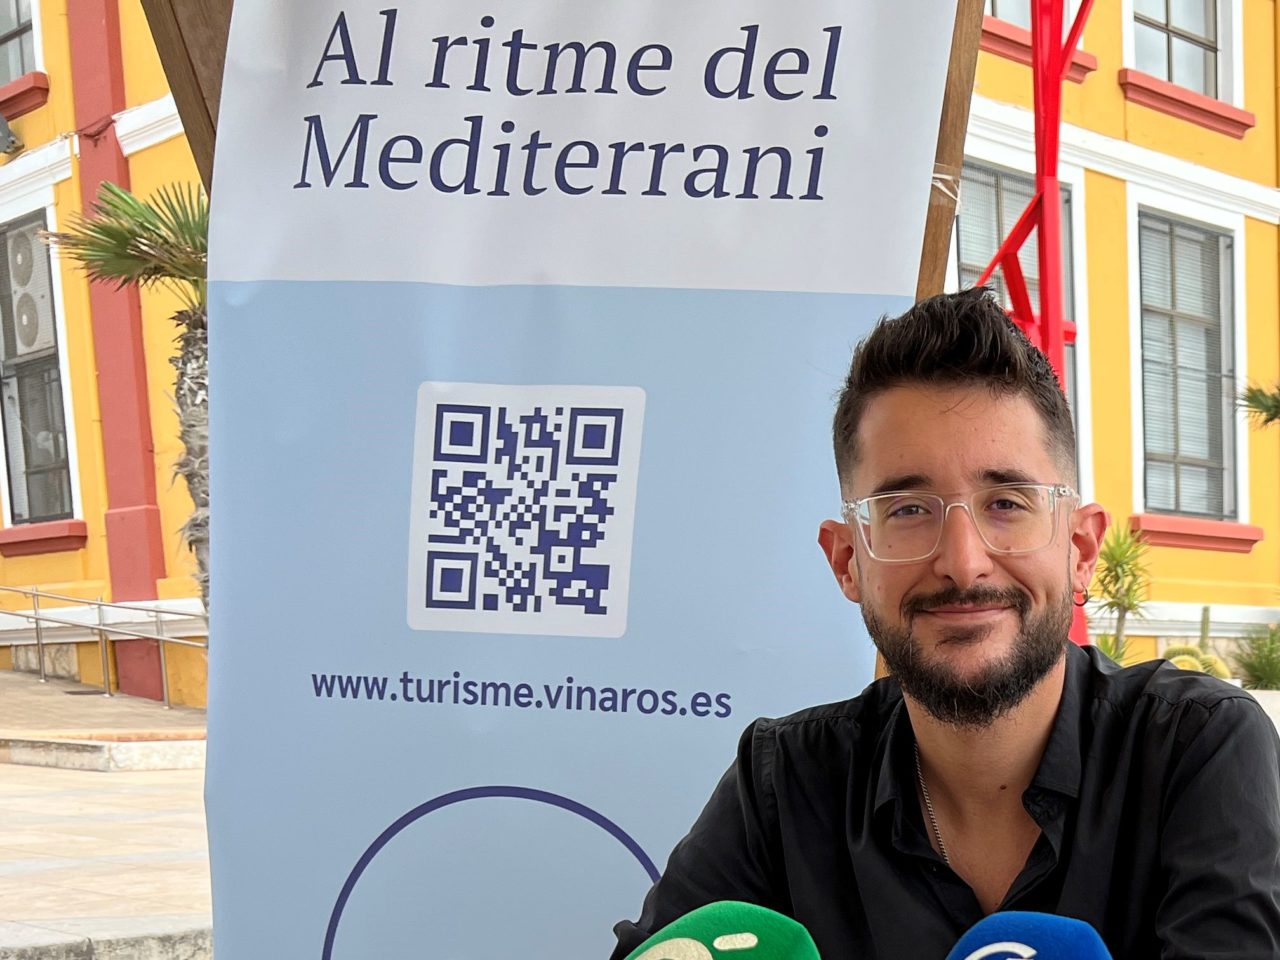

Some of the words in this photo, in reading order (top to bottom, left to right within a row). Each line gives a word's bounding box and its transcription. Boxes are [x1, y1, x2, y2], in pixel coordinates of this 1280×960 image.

[306, 8, 399, 88] Al
[424, 15, 673, 97] ritme
[703, 25, 843, 101] del
[293, 113, 830, 201] Mediterrani
[311, 671, 733, 719] www.turisme.vinaros.es
